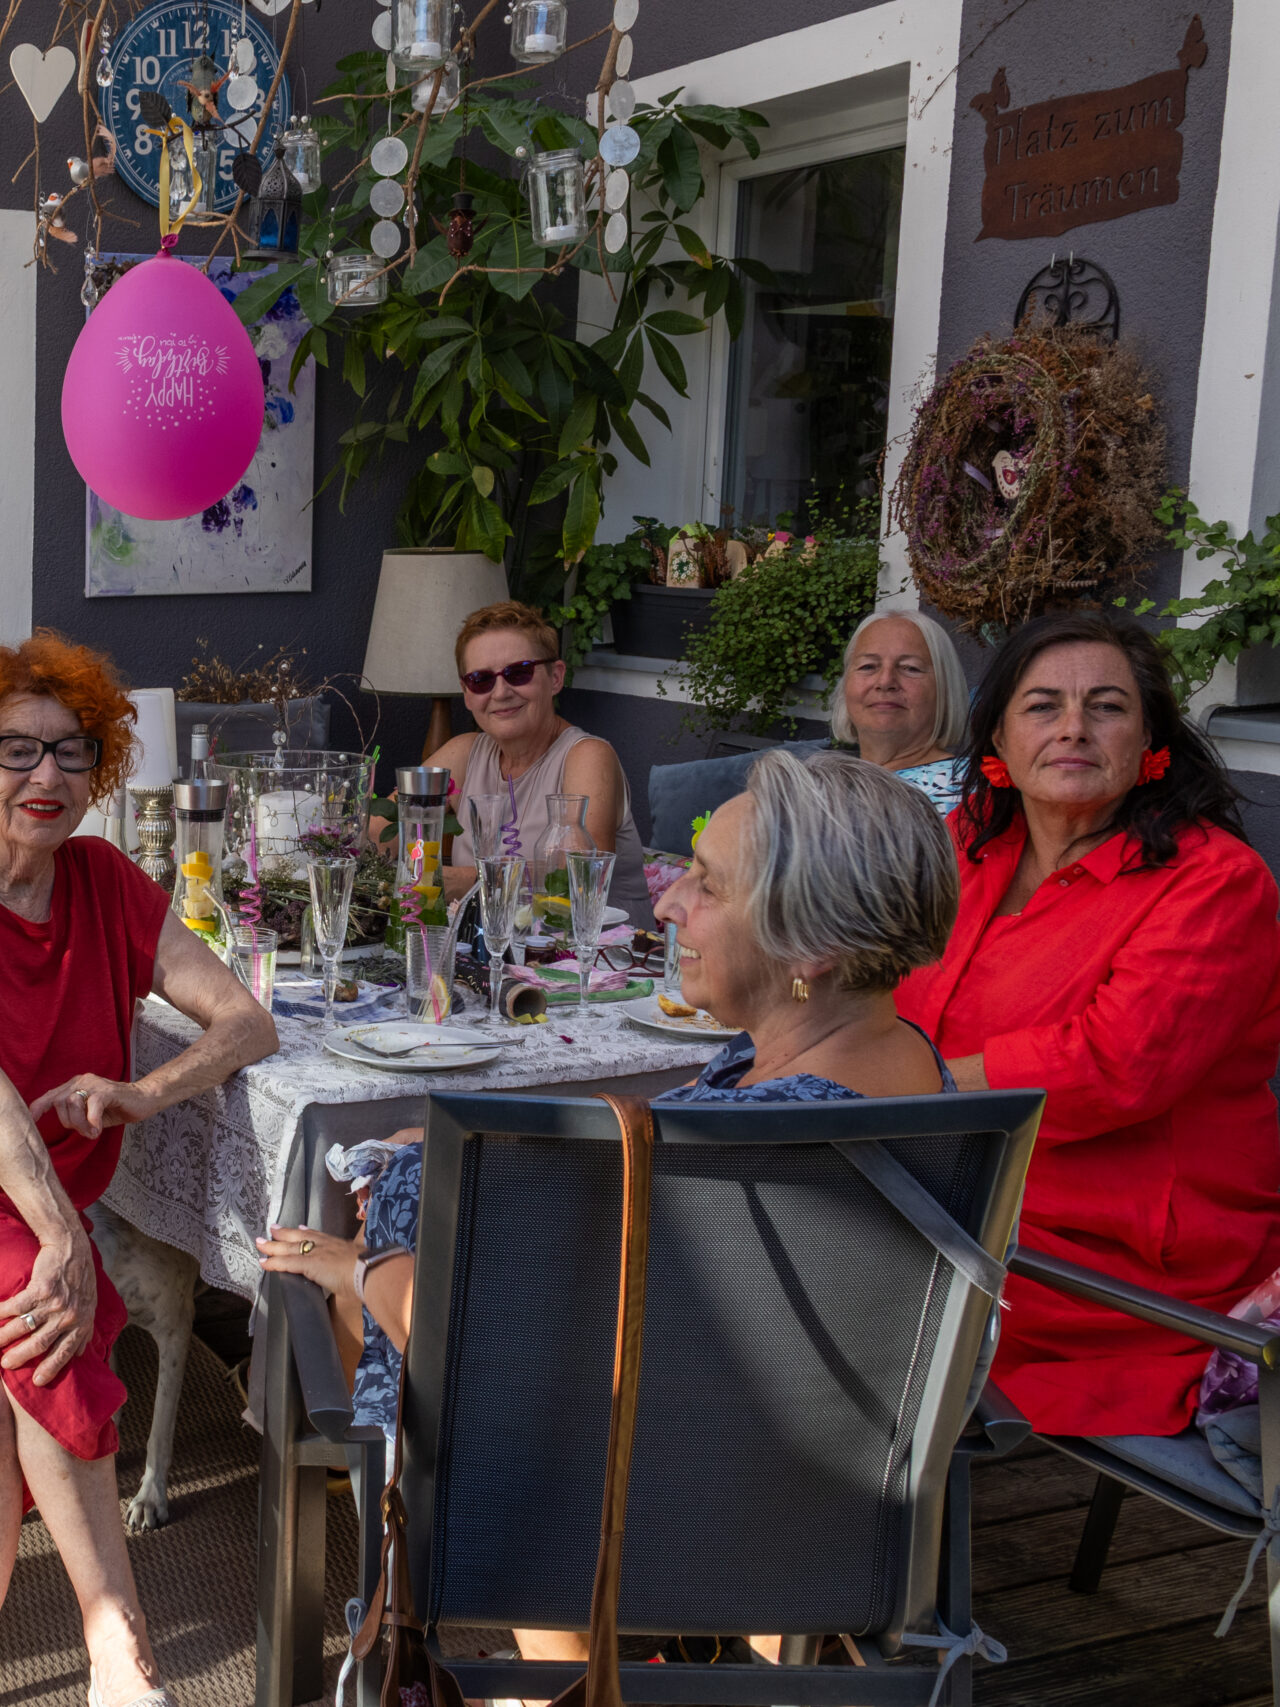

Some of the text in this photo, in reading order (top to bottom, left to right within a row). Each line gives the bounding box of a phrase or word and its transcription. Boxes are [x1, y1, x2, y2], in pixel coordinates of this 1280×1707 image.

[157, 29, 179, 57] 11
[182, 21, 210, 49] 12
[132, 56, 160, 85] 10
[126, 88, 141, 120] 9
[134, 124, 153, 155] 8
[994, 96, 1174, 165] Platz zum
[218, 150, 236, 180] 5
[1004, 166, 1159, 223] Träumen
[133, 335, 214, 379] Birthday
